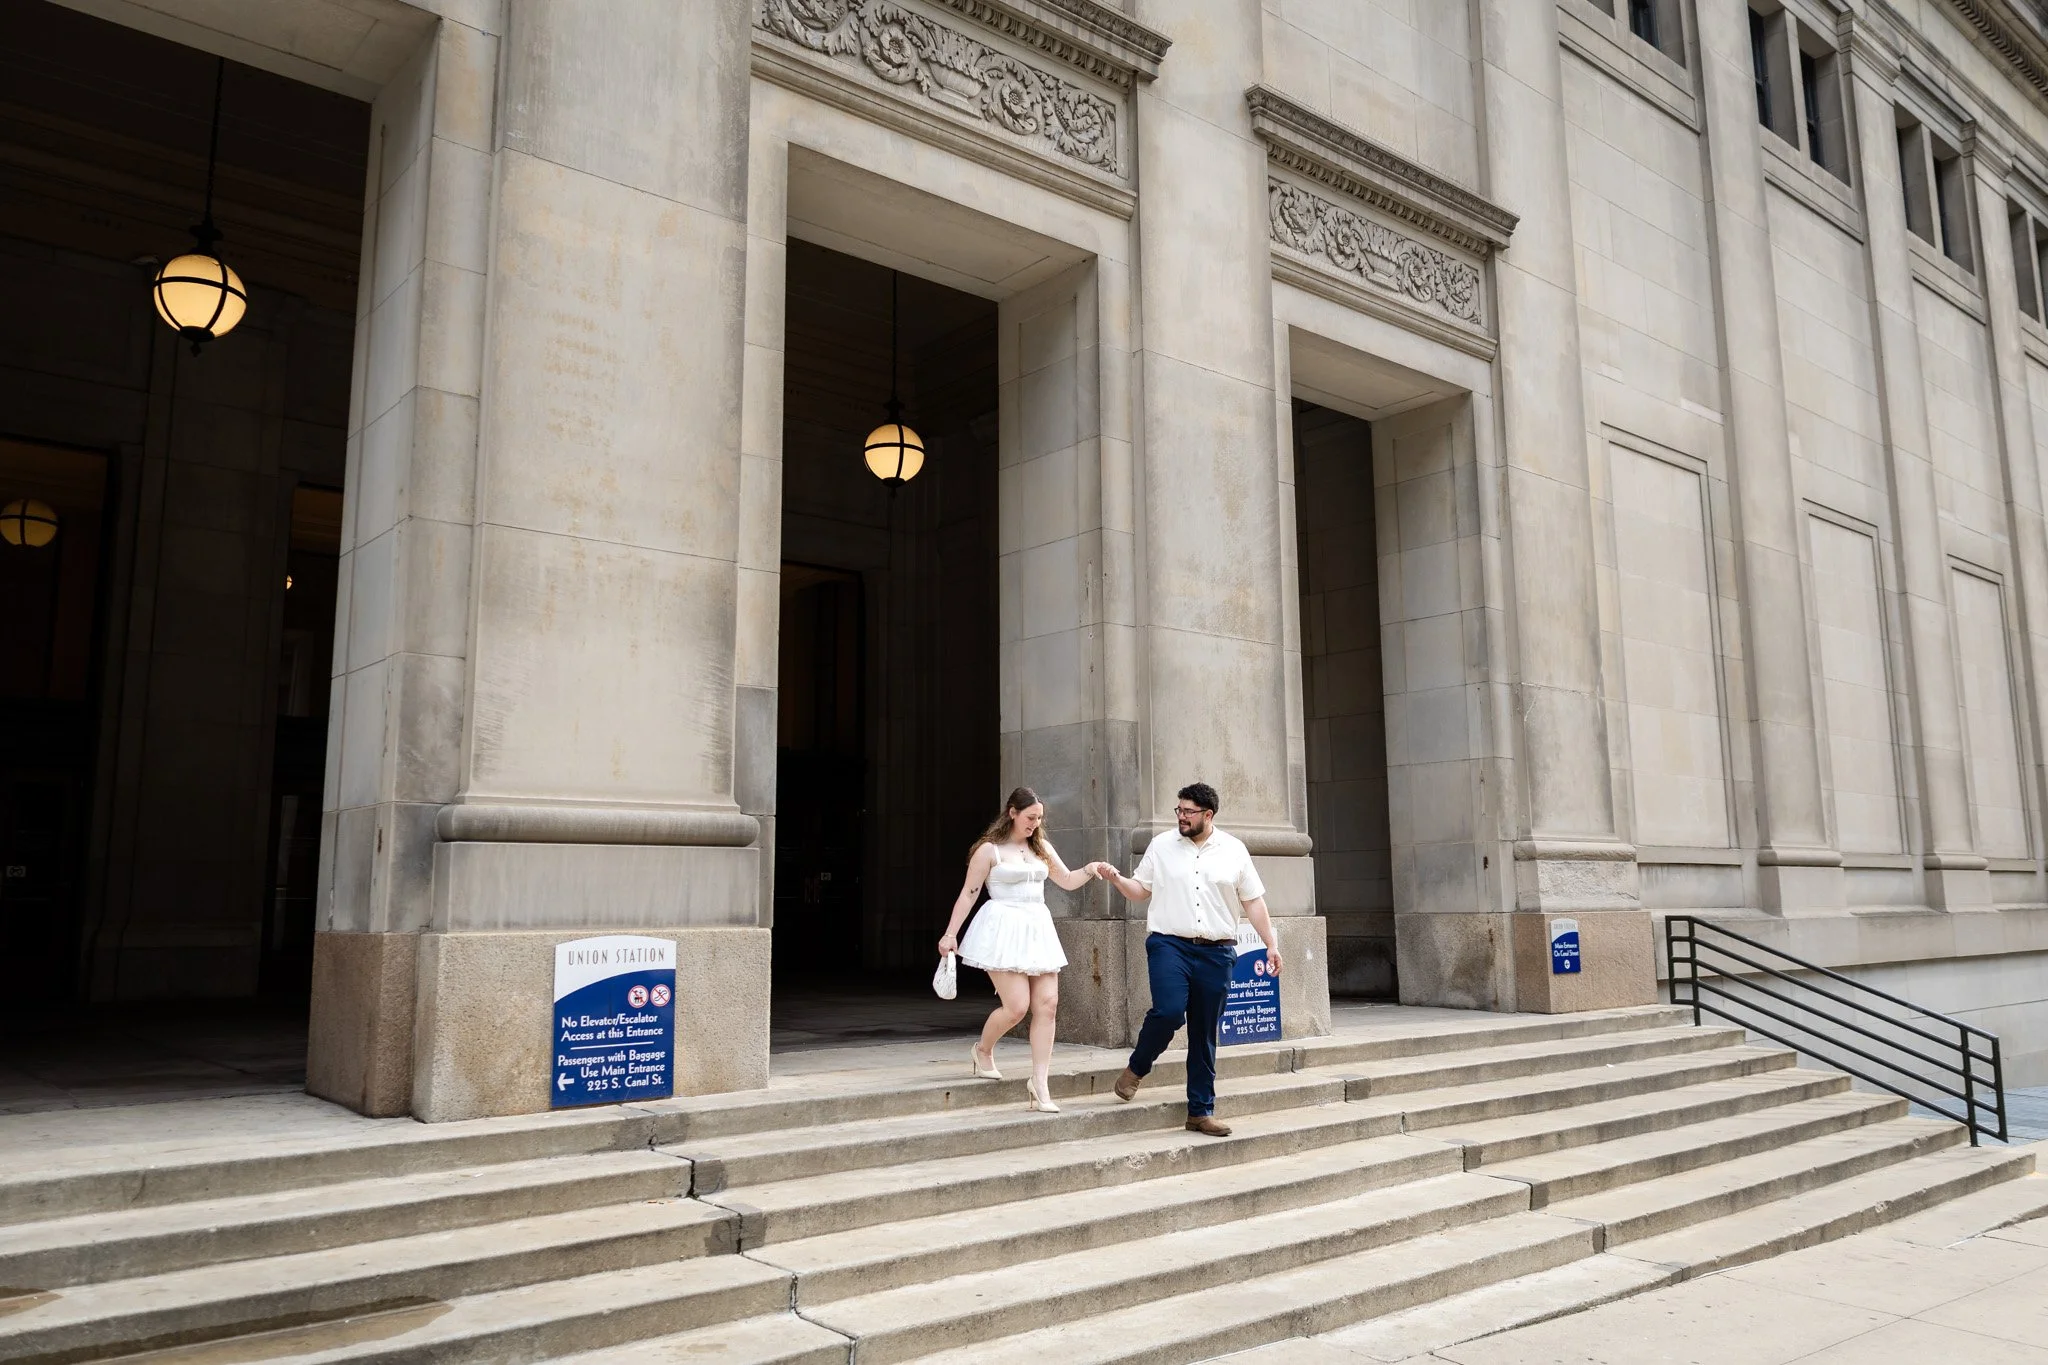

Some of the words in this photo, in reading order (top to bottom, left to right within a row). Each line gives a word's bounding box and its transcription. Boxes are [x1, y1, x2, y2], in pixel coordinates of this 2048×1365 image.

[568, 949, 608, 966] UNION
[616, 948, 665, 963] STATION
[1224, 1008, 1245, 1017] assengers
[1246, 1006, 1256, 1014] with
[1257, 1005, 1276, 1014] Baggage
[561, 1016, 577, 1028] No
[580, 1012, 658, 1027] Elevator/Escalator
[1233, 1017, 1242, 1025] Use
[1257, 1014, 1276, 1022] Entrance
[561, 1030, 594, 1042] Access
[597, 1030, 606, 1039] at
[608, 1028, 624, 1039] this
[626, 1026, 663, 1038] Entrance
[1237, 1026, 1248, 1034] 225
[1256, 1024, 1269, 1032] Canal
[558, 1055, 605, 1067] Passengers
[608, 1052, 626, 1062] with
[629, 1049, 665, 1062] Baggage
[581, 1067, 599, 1078] Use
[602, 1065, 626, 1077] Main
[628, 1063, 665, 1074] Entrance
[587, 1079, 608, 1091] 225
[611, 1078, 621, 1089] S.
[625, 1074, 649, 1087] Canal
[651, 1074, 664, 1085] St.
